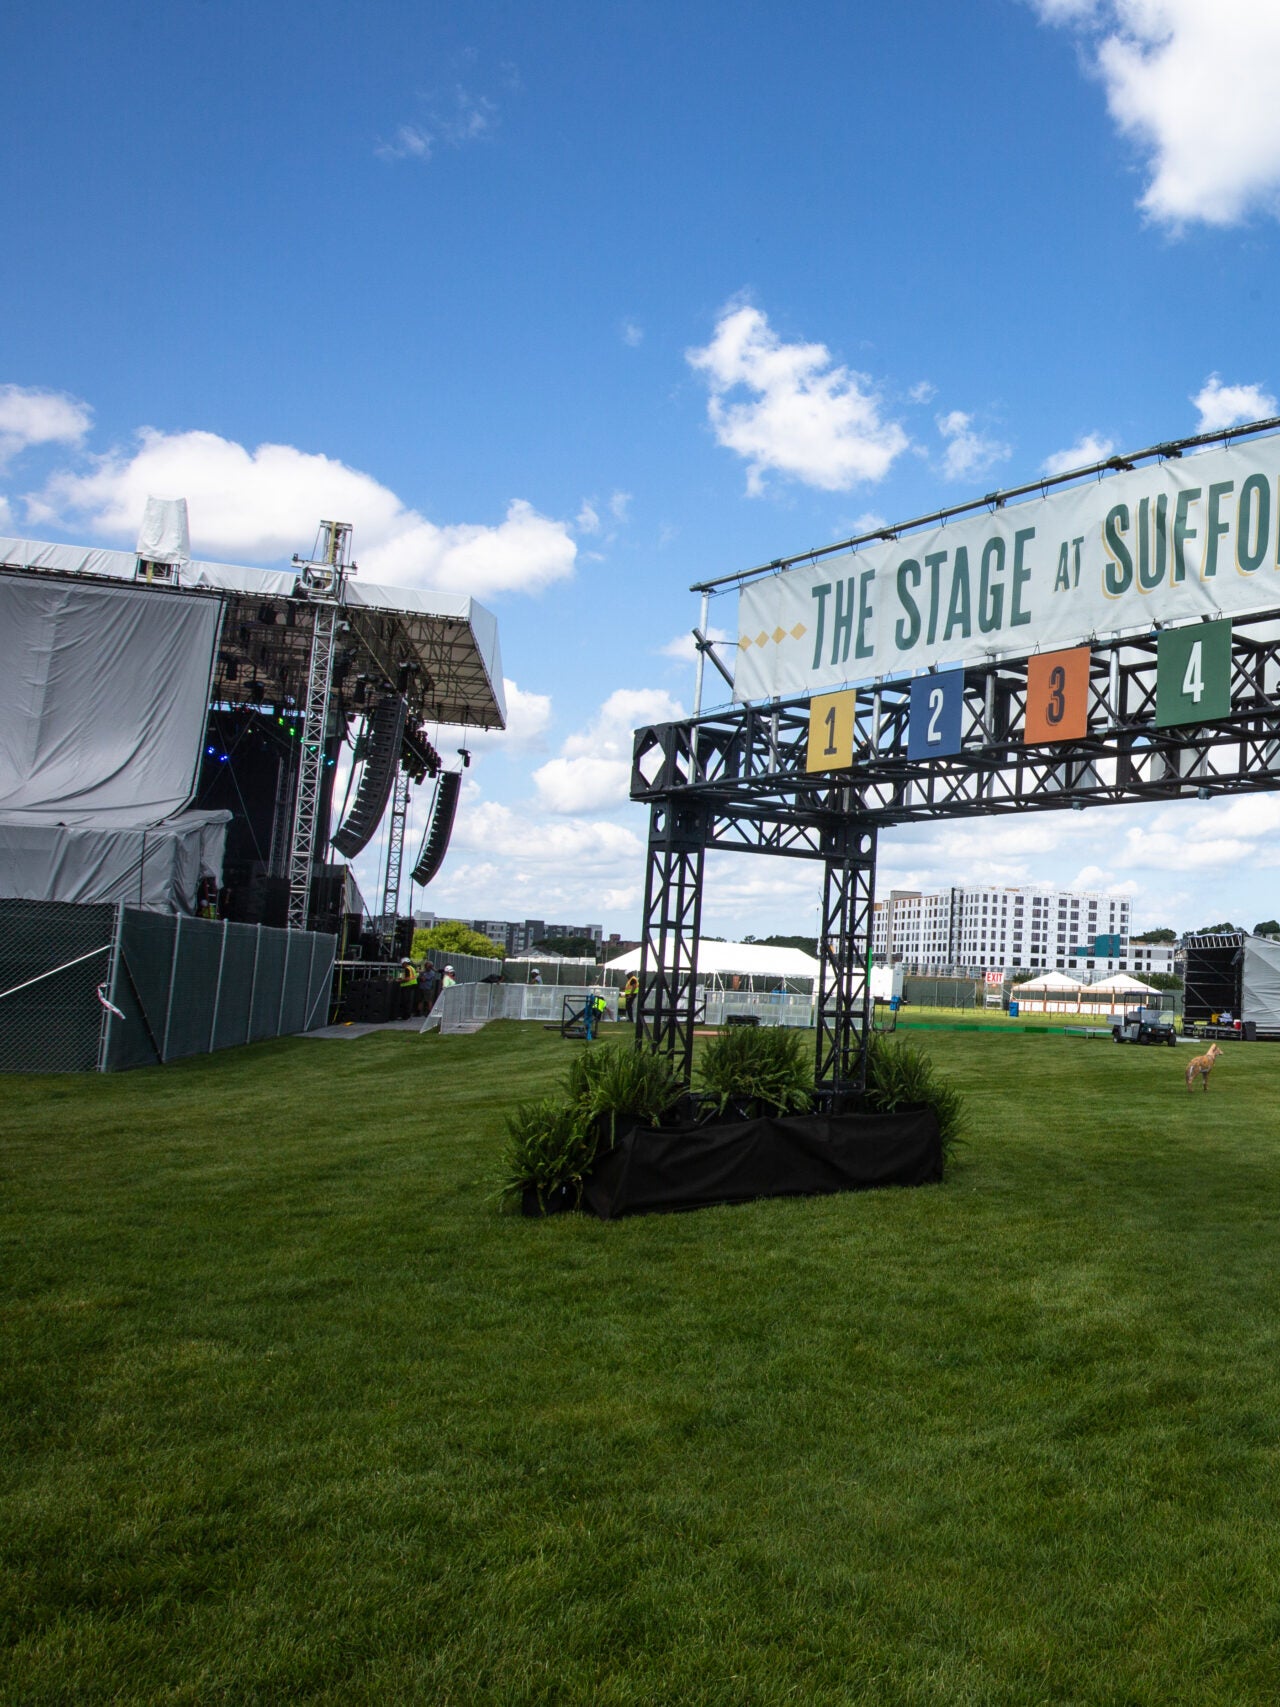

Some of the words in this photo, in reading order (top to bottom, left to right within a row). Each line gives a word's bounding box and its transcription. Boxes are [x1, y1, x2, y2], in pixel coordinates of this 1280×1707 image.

[811, 568, 876, 670] THE
[894, 527, 1036, 651] STAGE
[1053, 536, 1085, 593] AT
[1046, 665, 1066, 727] 3
[1180, 640, 1205, 703] 4
[823, 706, 837, 755] 1
[927, 687, 944, 746] 2
[987, 973, 1003, 982] EXIT
